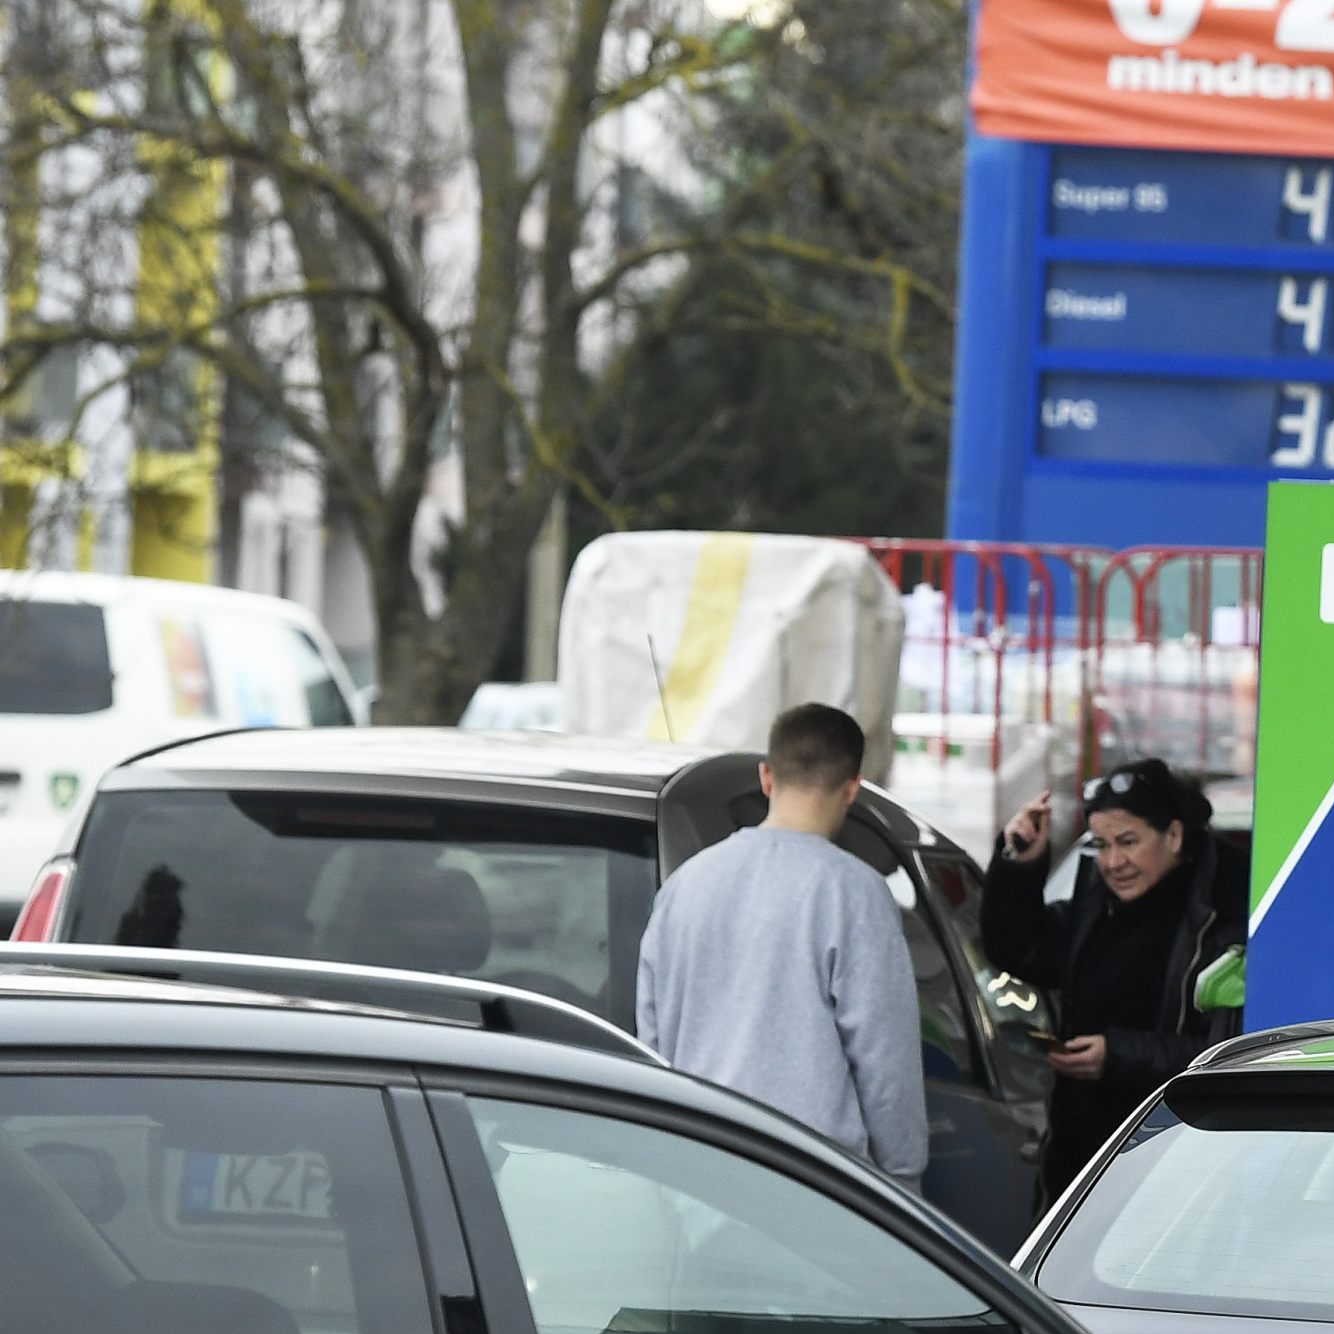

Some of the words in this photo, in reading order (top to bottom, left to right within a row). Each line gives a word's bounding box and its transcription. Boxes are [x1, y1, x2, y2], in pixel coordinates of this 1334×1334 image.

[1106, 48, 1334, 100] minden
[1053, 177, 1129, 214] Super
[1045, 289, 1127, 320] Diesel
[1042, 399, 1097, 430] LPG
